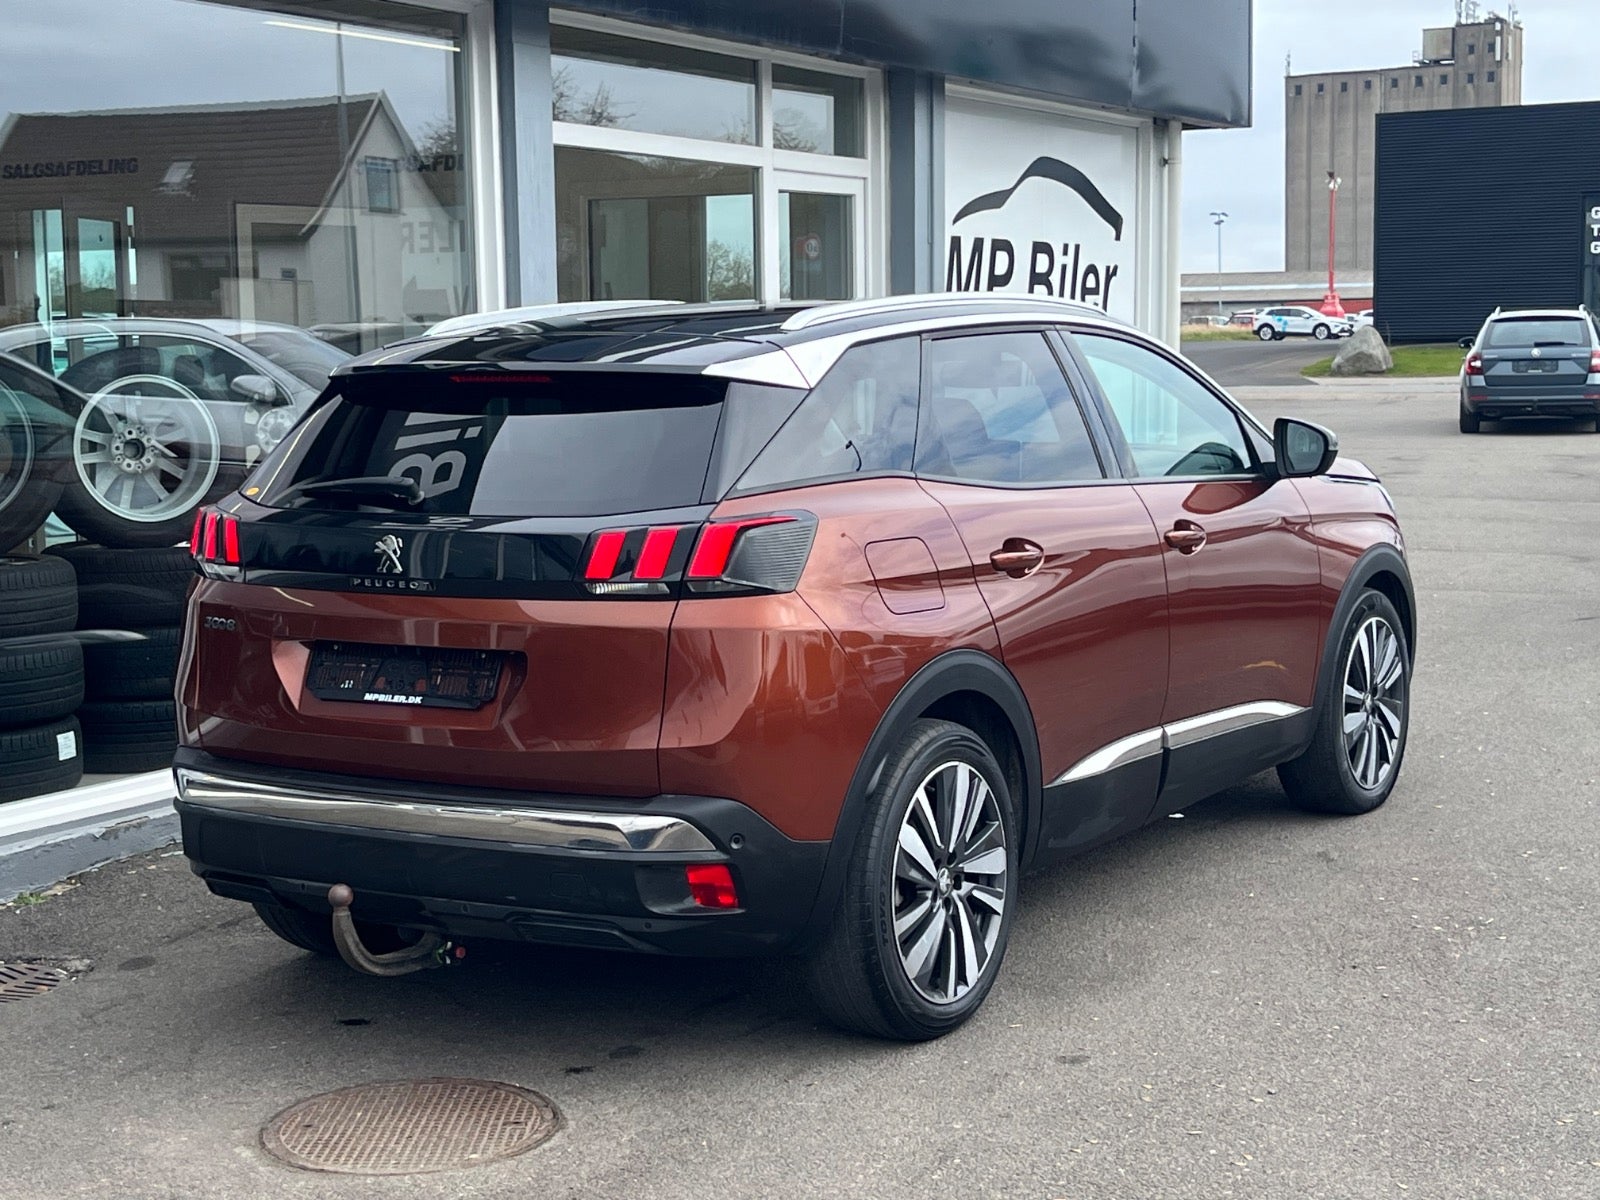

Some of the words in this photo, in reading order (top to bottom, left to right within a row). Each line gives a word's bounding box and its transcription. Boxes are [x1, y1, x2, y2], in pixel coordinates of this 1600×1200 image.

[2, 158, 138, 179] SALGSAFDELING
[946, 235, 1015, 293] MP
[1027, 241, 1119, 313] Biler
[363, 692, 423, 704] MPBILER.DK
